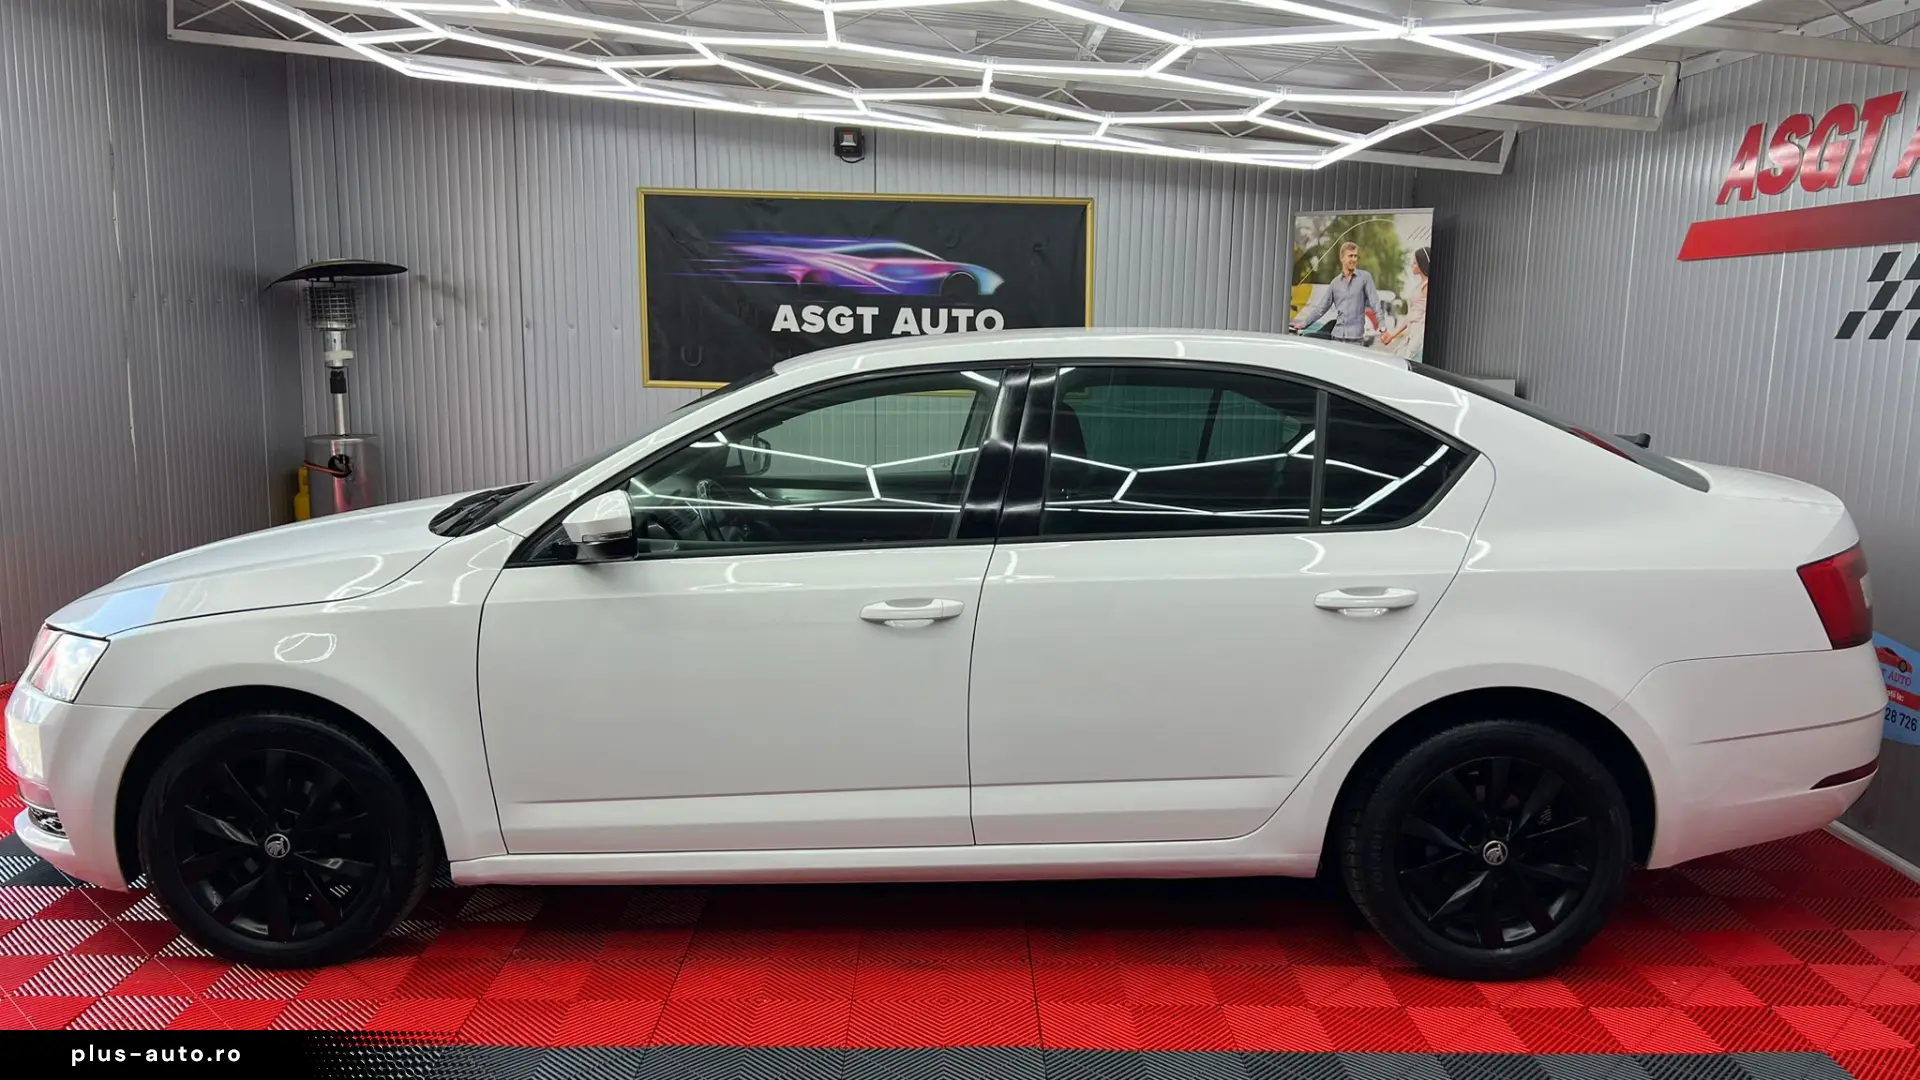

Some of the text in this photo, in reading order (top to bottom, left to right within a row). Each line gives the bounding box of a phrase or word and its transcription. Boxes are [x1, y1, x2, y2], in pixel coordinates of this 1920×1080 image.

[1715, 90, 1907, 205] ASGT
[771, 304, 1005, 335] ASGT AUTO
[1888, 672, 1911, 686] AUTO
[1884, 707, 1917, 731] 28 726
